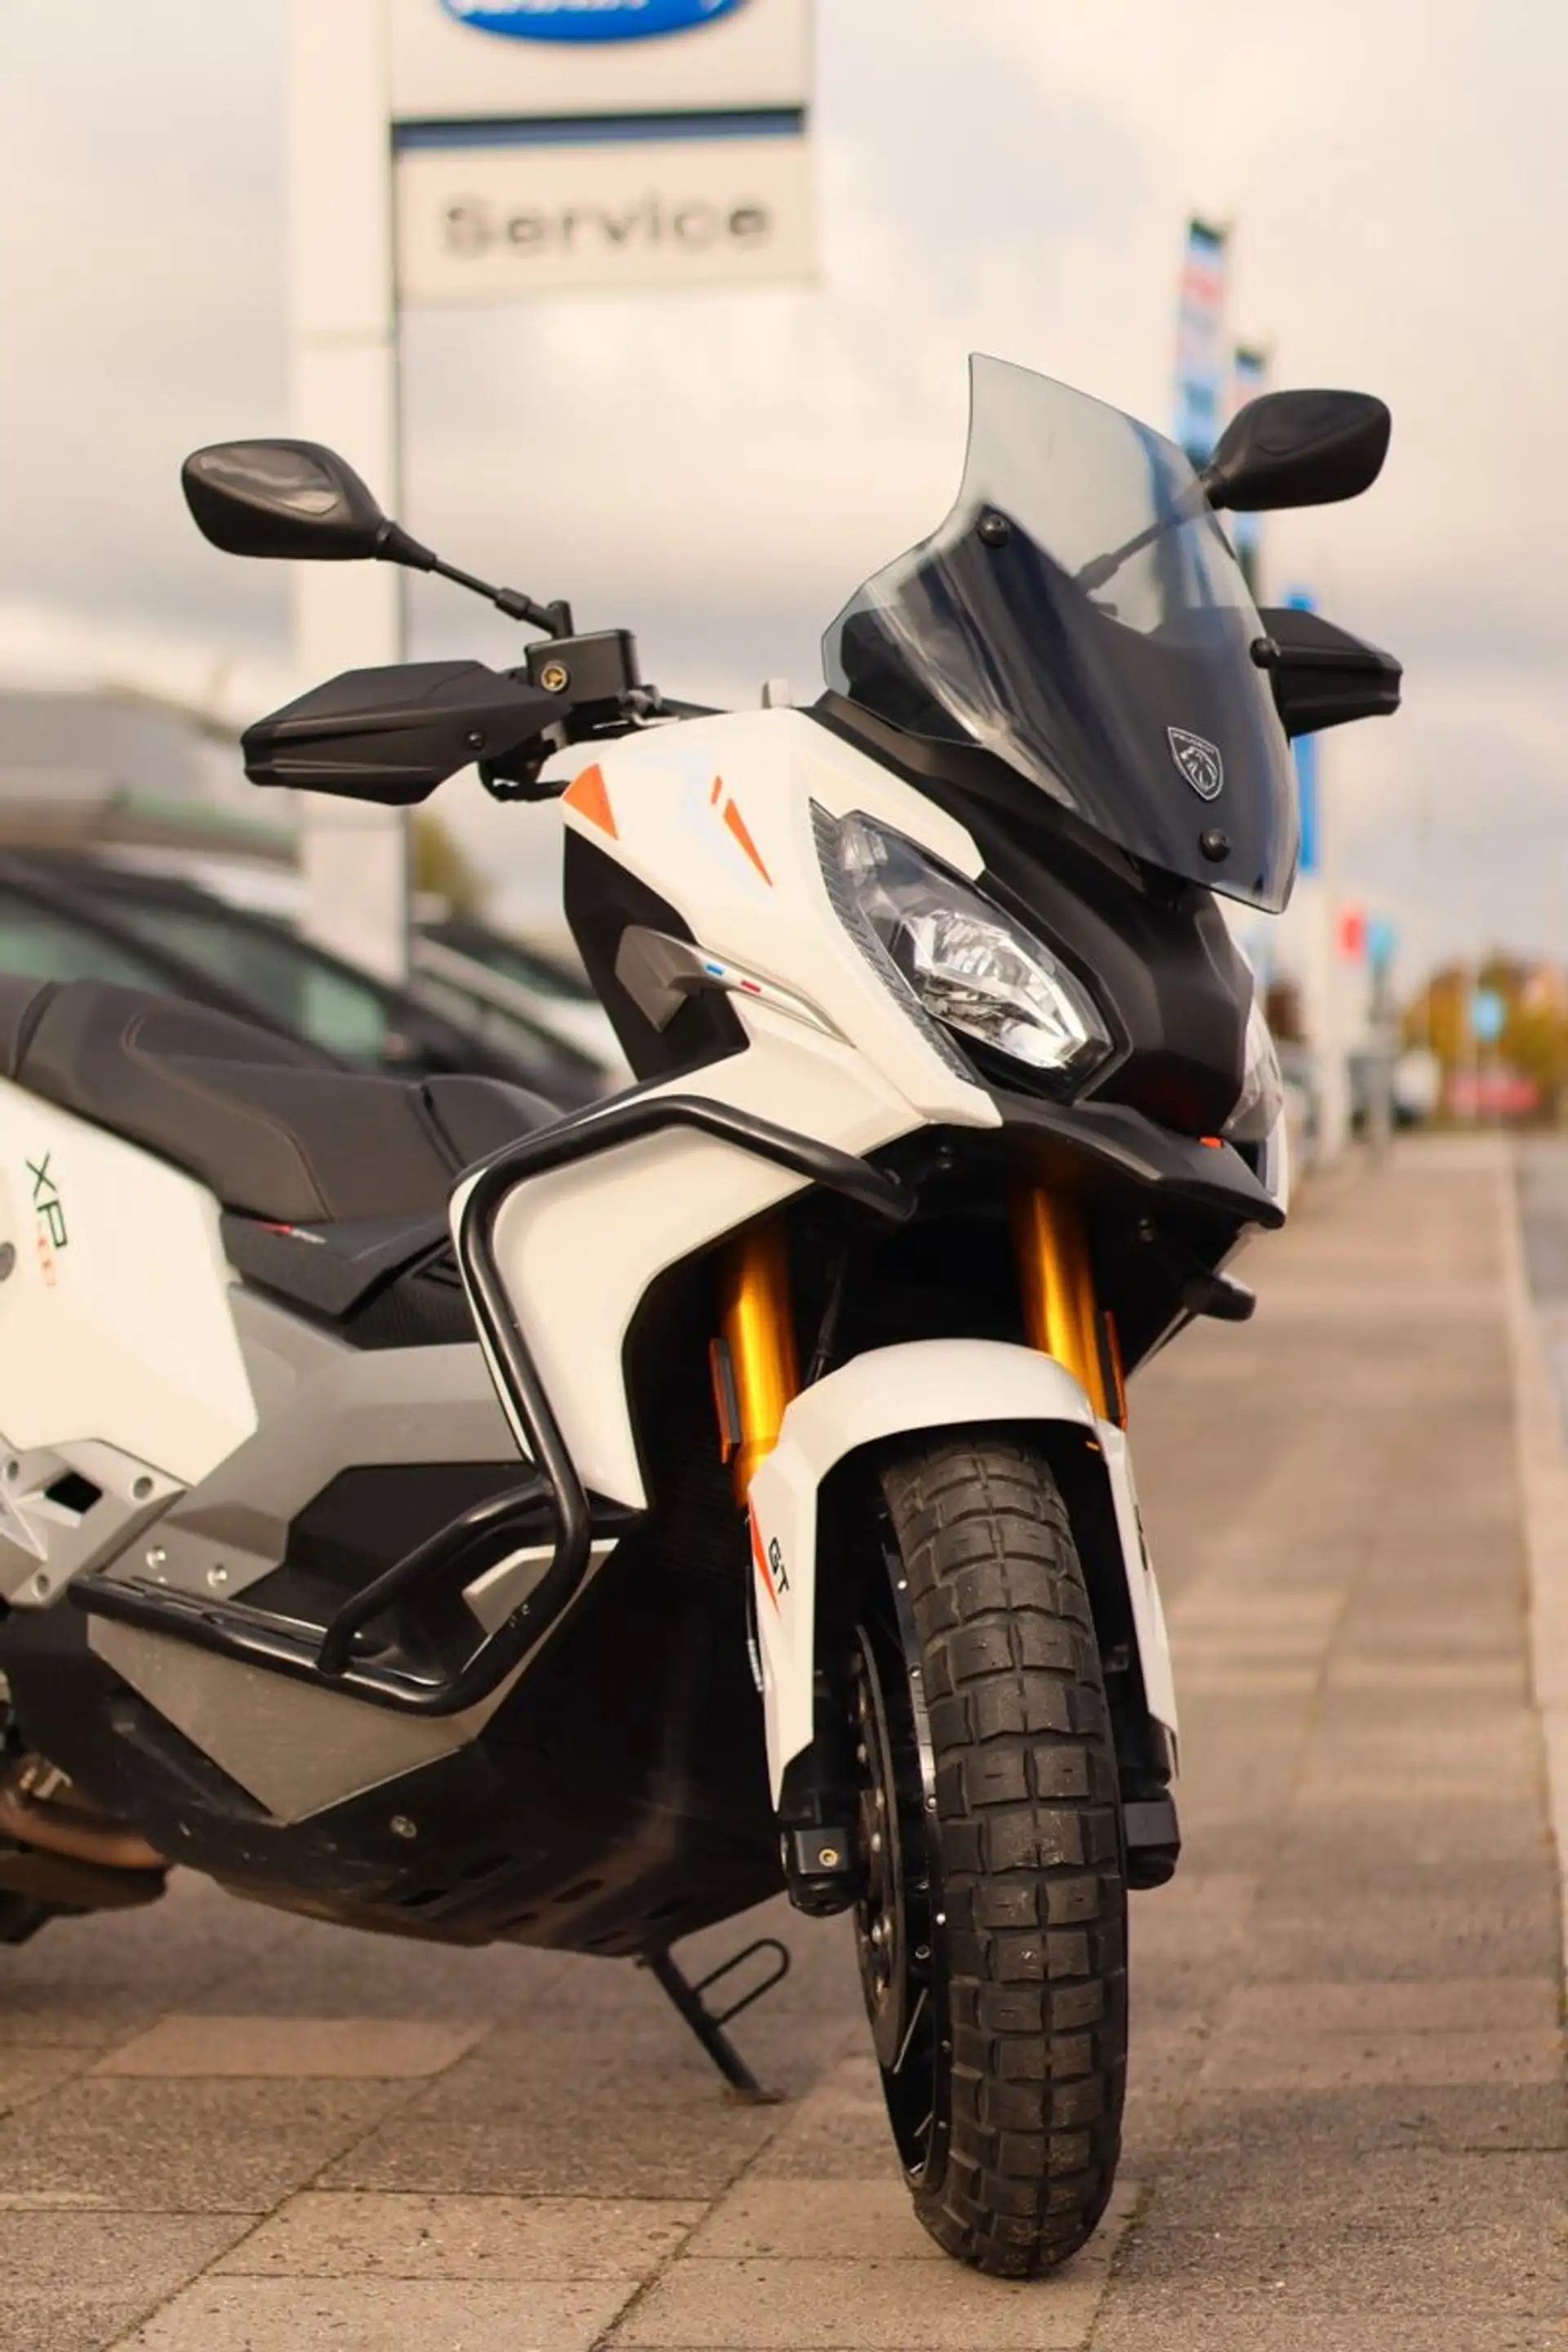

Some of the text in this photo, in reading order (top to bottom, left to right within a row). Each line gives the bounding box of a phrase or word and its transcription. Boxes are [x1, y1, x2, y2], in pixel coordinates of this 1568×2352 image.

[446, 194, 768, 256] Service
[25, 1150, 67, 1249] XP
[768, 1535, 790, 1594] GT
